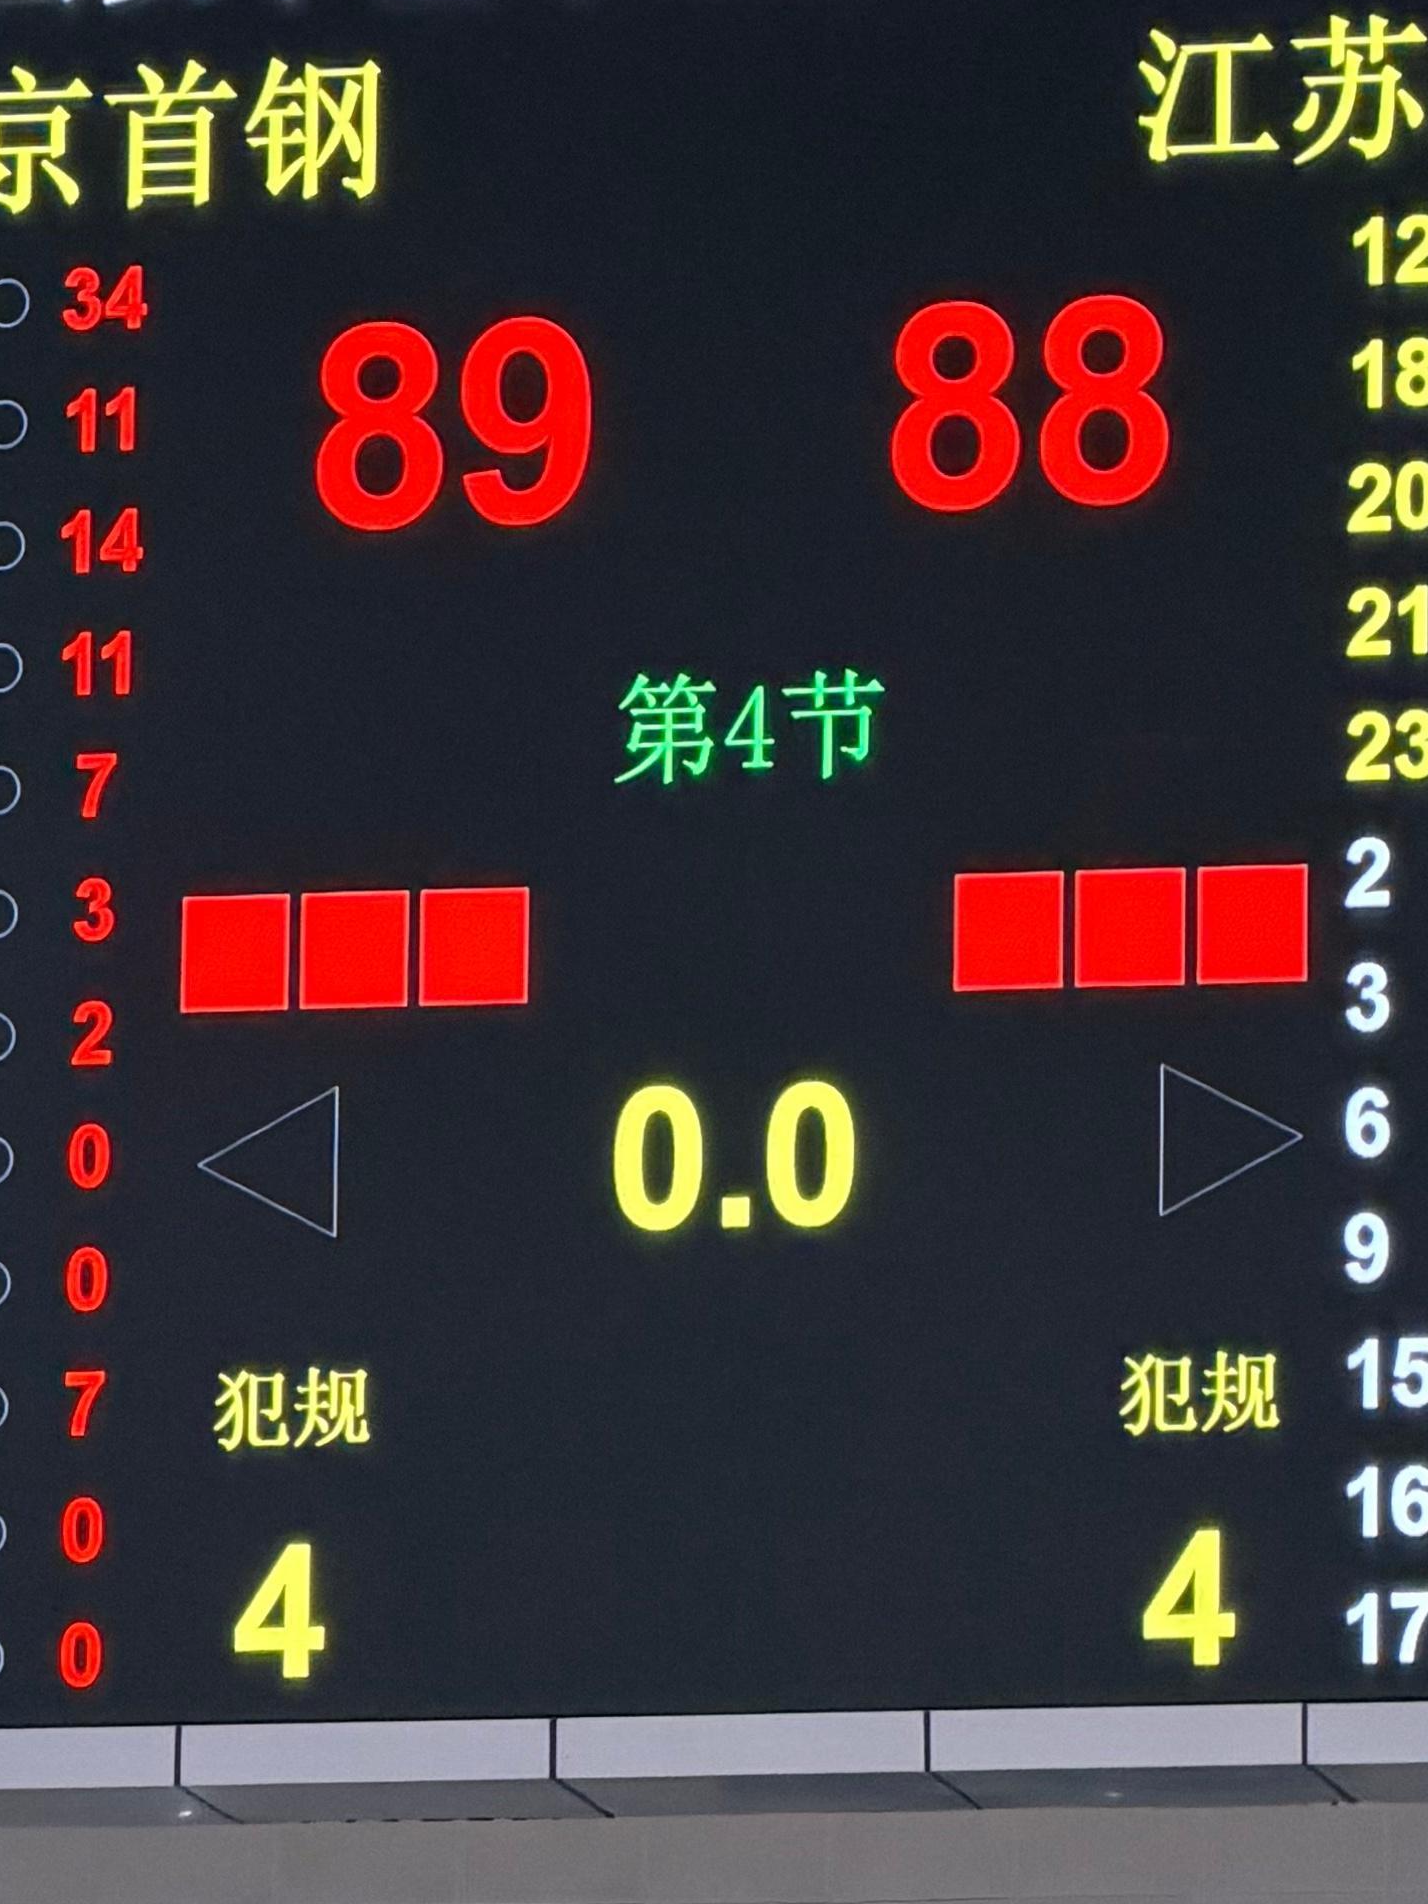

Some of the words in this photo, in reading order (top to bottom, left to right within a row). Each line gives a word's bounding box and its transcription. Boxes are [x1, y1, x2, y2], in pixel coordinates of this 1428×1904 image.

[63, 265, 148, 331] 34
[66, 387, 135, 453] 11
[314, 316, 592, 531] 89
[889, 294, 1170, 512] 88
[61, 508, 144, 574] 14
[61, 630, 131, 696] 11
[614, 669, 885, 784] 第4节
[76, 752, 117, 819] 7
[1344, 836, 1391, 909] 2
[73, 877, 115, 942] 3
[1345, 960, 1391, 1033] 3
[71, 1000, 112, 1067] 2
[67, 1123, 111, 1190] 0
[613, 1079, 855, 1232] 0.0
[1343, 1086, 1391, 1159] 6
[64, 1246, 108, 1313] 0
[1343, 1210, 1390, 1284] 9
[65, 1370, 106, 1437] 7
[213, 1366, 370, 1451] 犯规
[1119, 1350, 1280, 1436] 犯规
[60, 1497, 105, 1564] 0
[233, 1541, 326, 1680] 4
[1142, 1527, 1236, 1666] 4
[58, 1621, 102, 1689] 0
